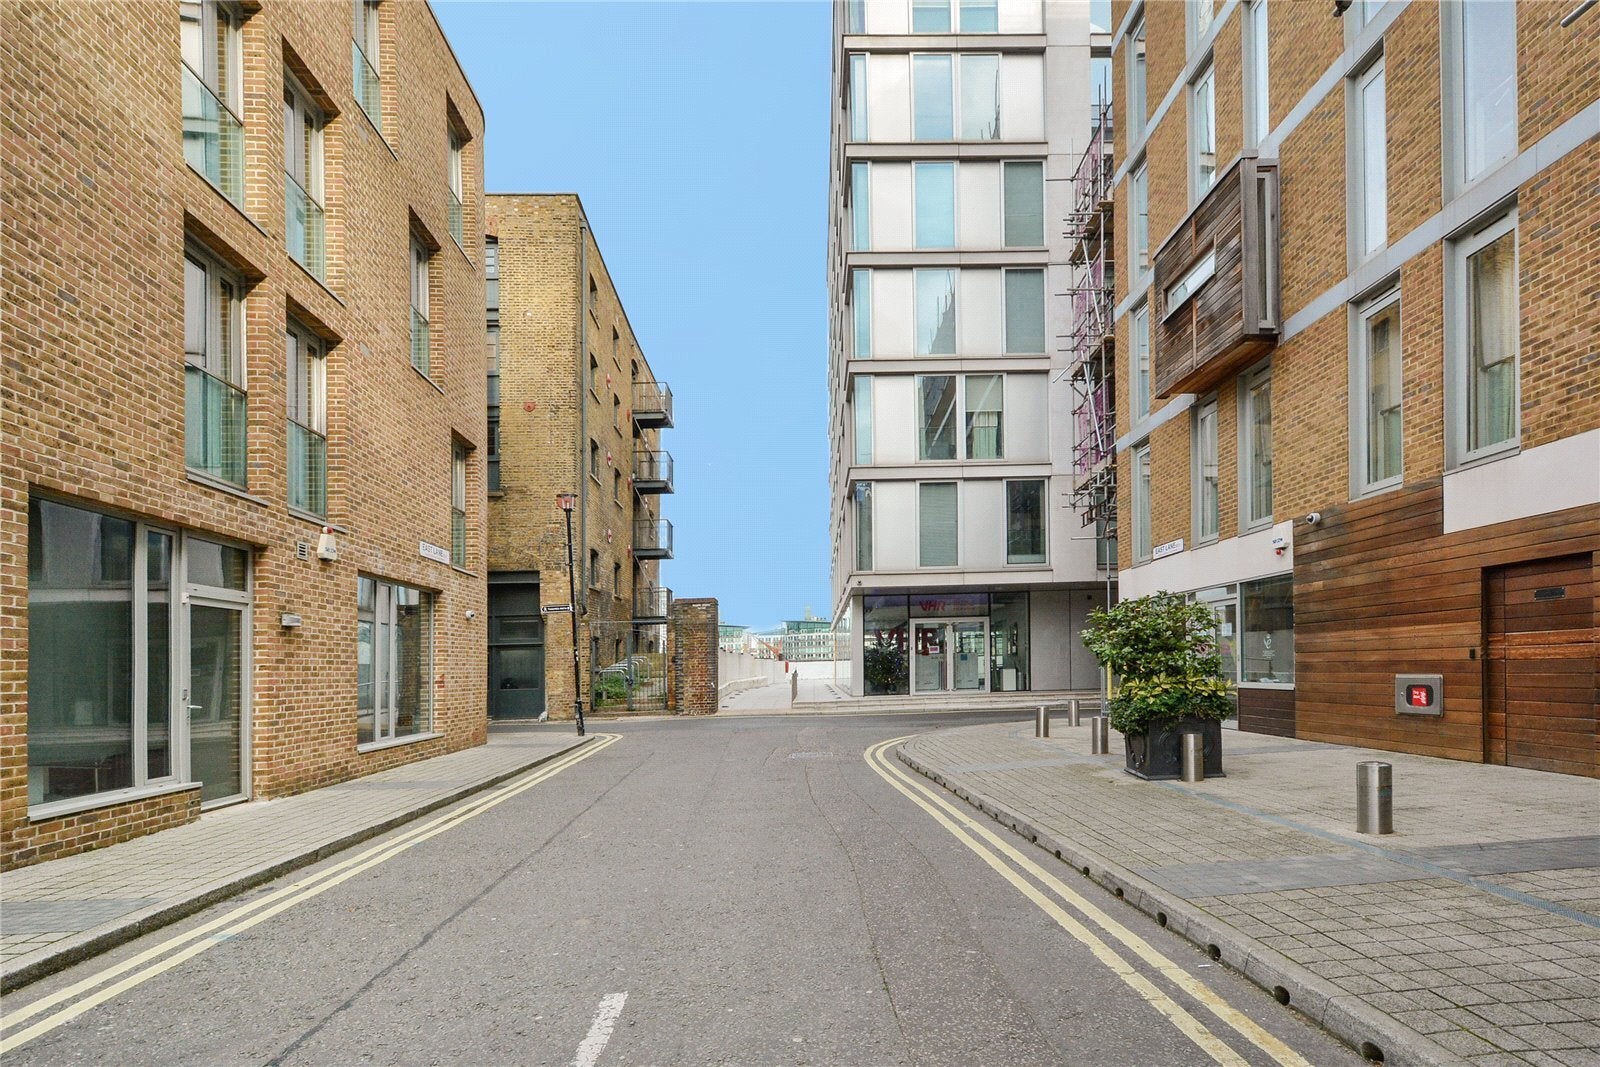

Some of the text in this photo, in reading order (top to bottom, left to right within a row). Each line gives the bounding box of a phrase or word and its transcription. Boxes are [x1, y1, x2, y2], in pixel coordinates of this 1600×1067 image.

[422, 543, 433, 553] EAST
[433, 547, 443, 557] LANE
[1155, 546, 1165, 555] EAST
[1165, 542, 1176, 551] LANE
